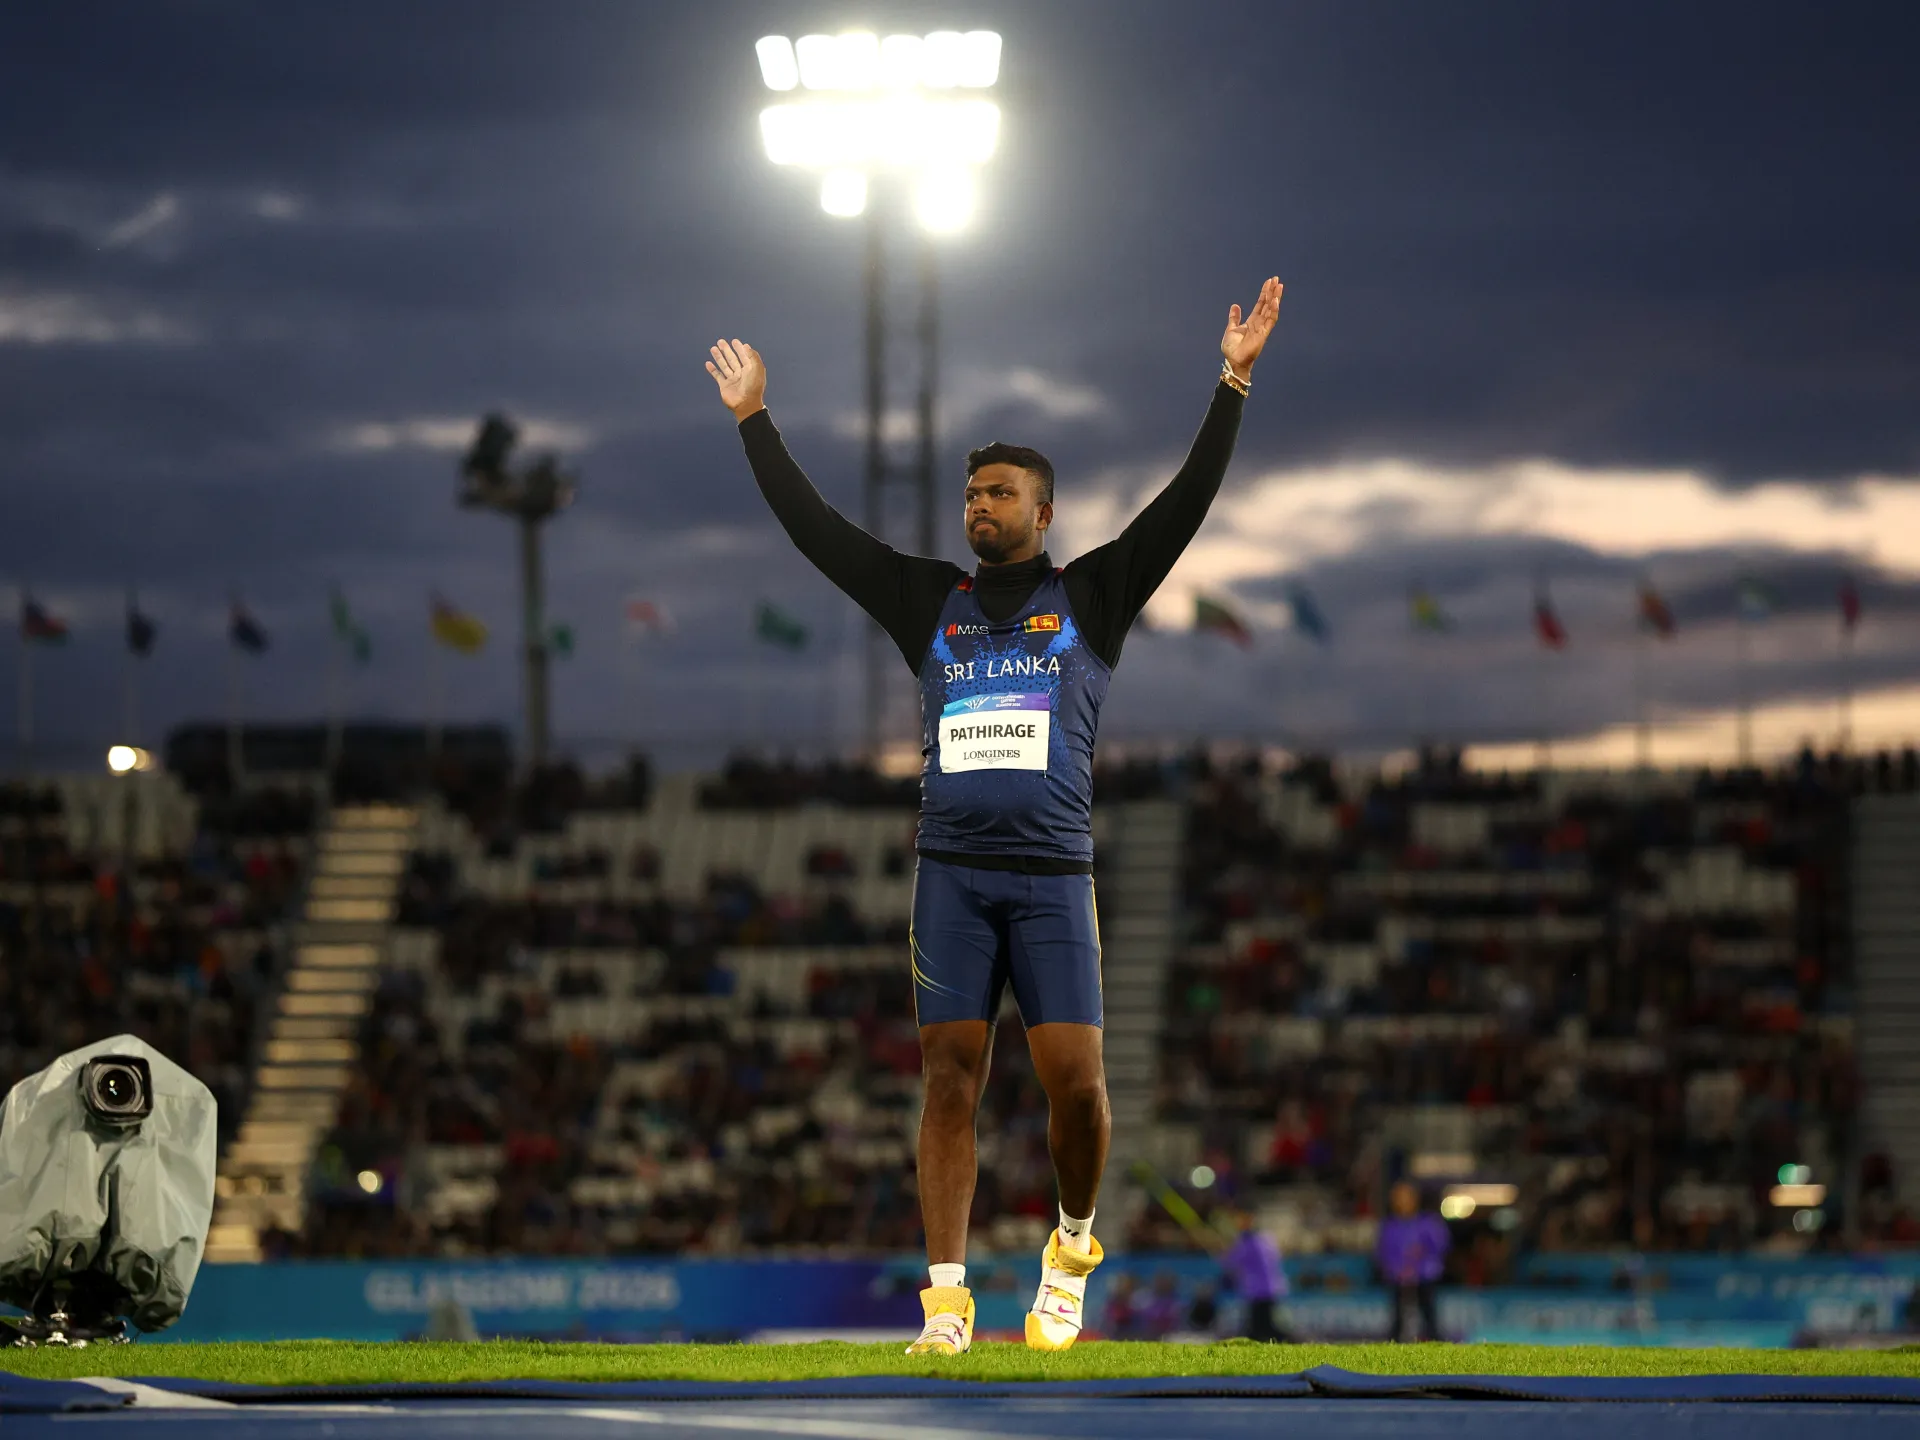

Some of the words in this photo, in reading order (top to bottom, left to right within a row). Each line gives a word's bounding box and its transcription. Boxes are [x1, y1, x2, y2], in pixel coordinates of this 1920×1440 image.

[957, 625, 989, 635] MAS
[944, 662, 975, 683] SRI
[987, 656, 1061, 678] LANKA
[950, 723, 1036, 742] PATHIRAGE
[963, 749, 1021, 760] LONGINES
